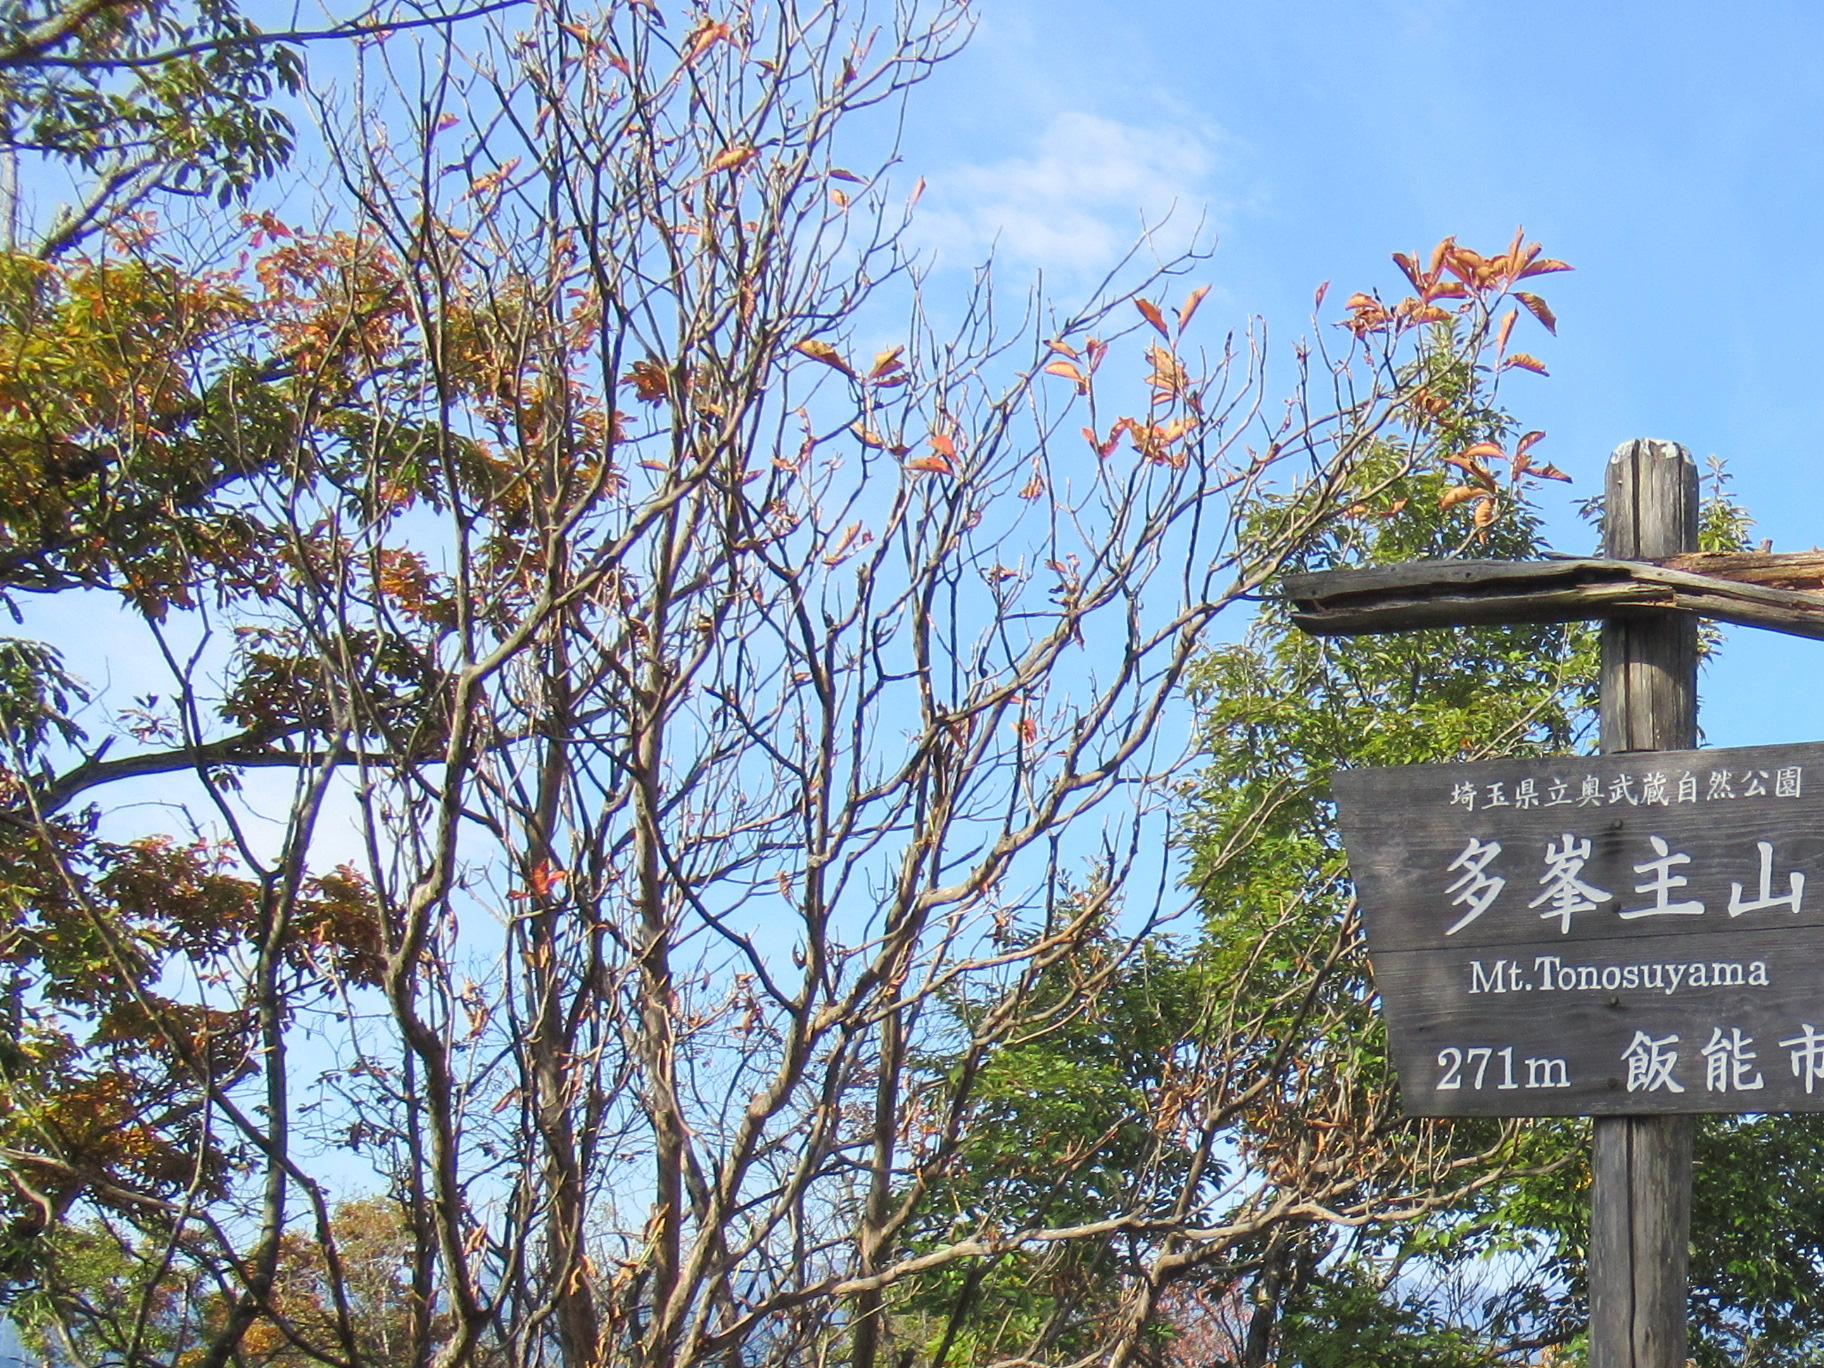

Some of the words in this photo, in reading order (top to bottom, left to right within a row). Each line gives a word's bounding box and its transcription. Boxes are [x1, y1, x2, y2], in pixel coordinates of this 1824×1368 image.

[1450, 766, 1802, 812] 埼玉県立奥武蔵自然公園
[1444, 833, 1805, 936] 多峯主山
[1436, 1046, 1571, 1090] 271m
